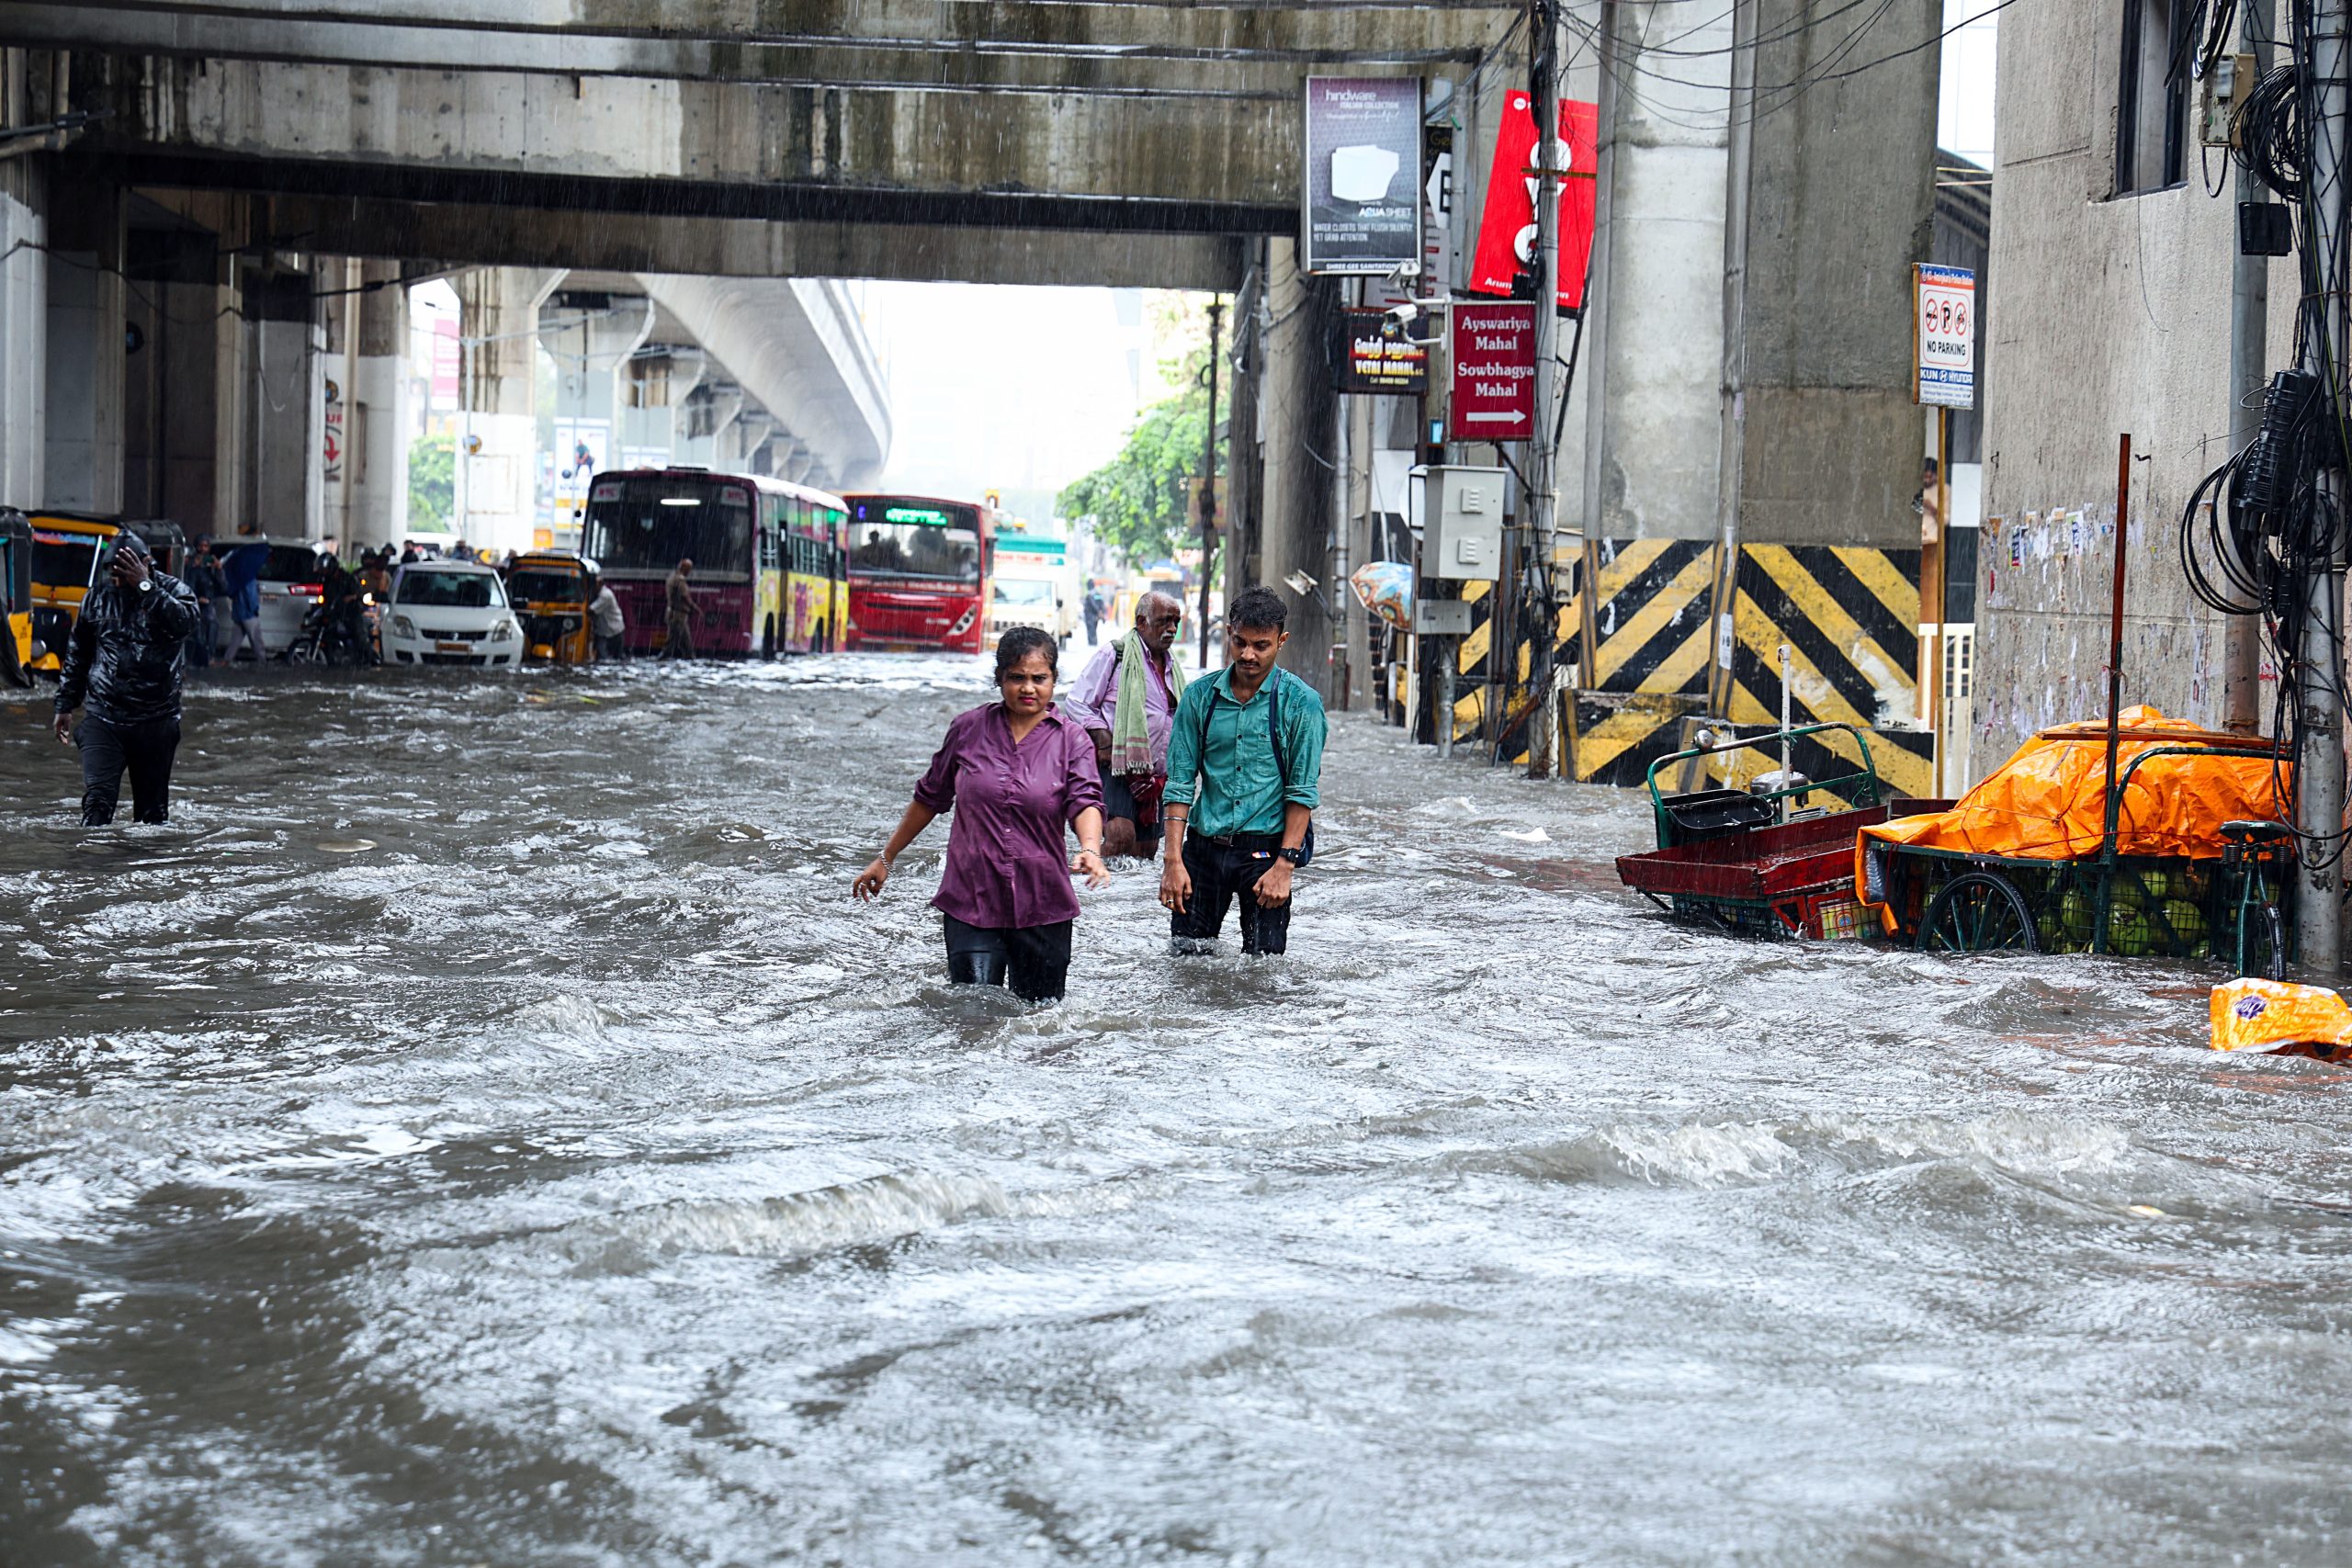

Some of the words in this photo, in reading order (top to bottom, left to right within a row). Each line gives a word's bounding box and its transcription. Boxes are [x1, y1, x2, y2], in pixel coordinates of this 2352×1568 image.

[1326, 89, 1376, 101] hindware
[1359, 208, 1385, 217] AQUA
[1385, 208, 1412, 219] SHEET
[1314, 223, 1331, 231] WATER
[1332, 223, 1356, 231] CLOSETS
[1358, 223, 1370, 231] THAT
[1325, 233, 1339, 242] GRAB
[1462, 316, 1531, 333] Ayswariya
[1476, 336, 1517, 350] Mahal
[1927, 341, 1937, 353] NO
[1939, 342, 1966, 356] PARKING
[1383, 361, 1415, 376] MAHAL
[1458, 362, 1534, 378] Sowbhagya
[1920, 368, 1939, 380] KUN
[1476, 382, 1517, 397] Mahal
